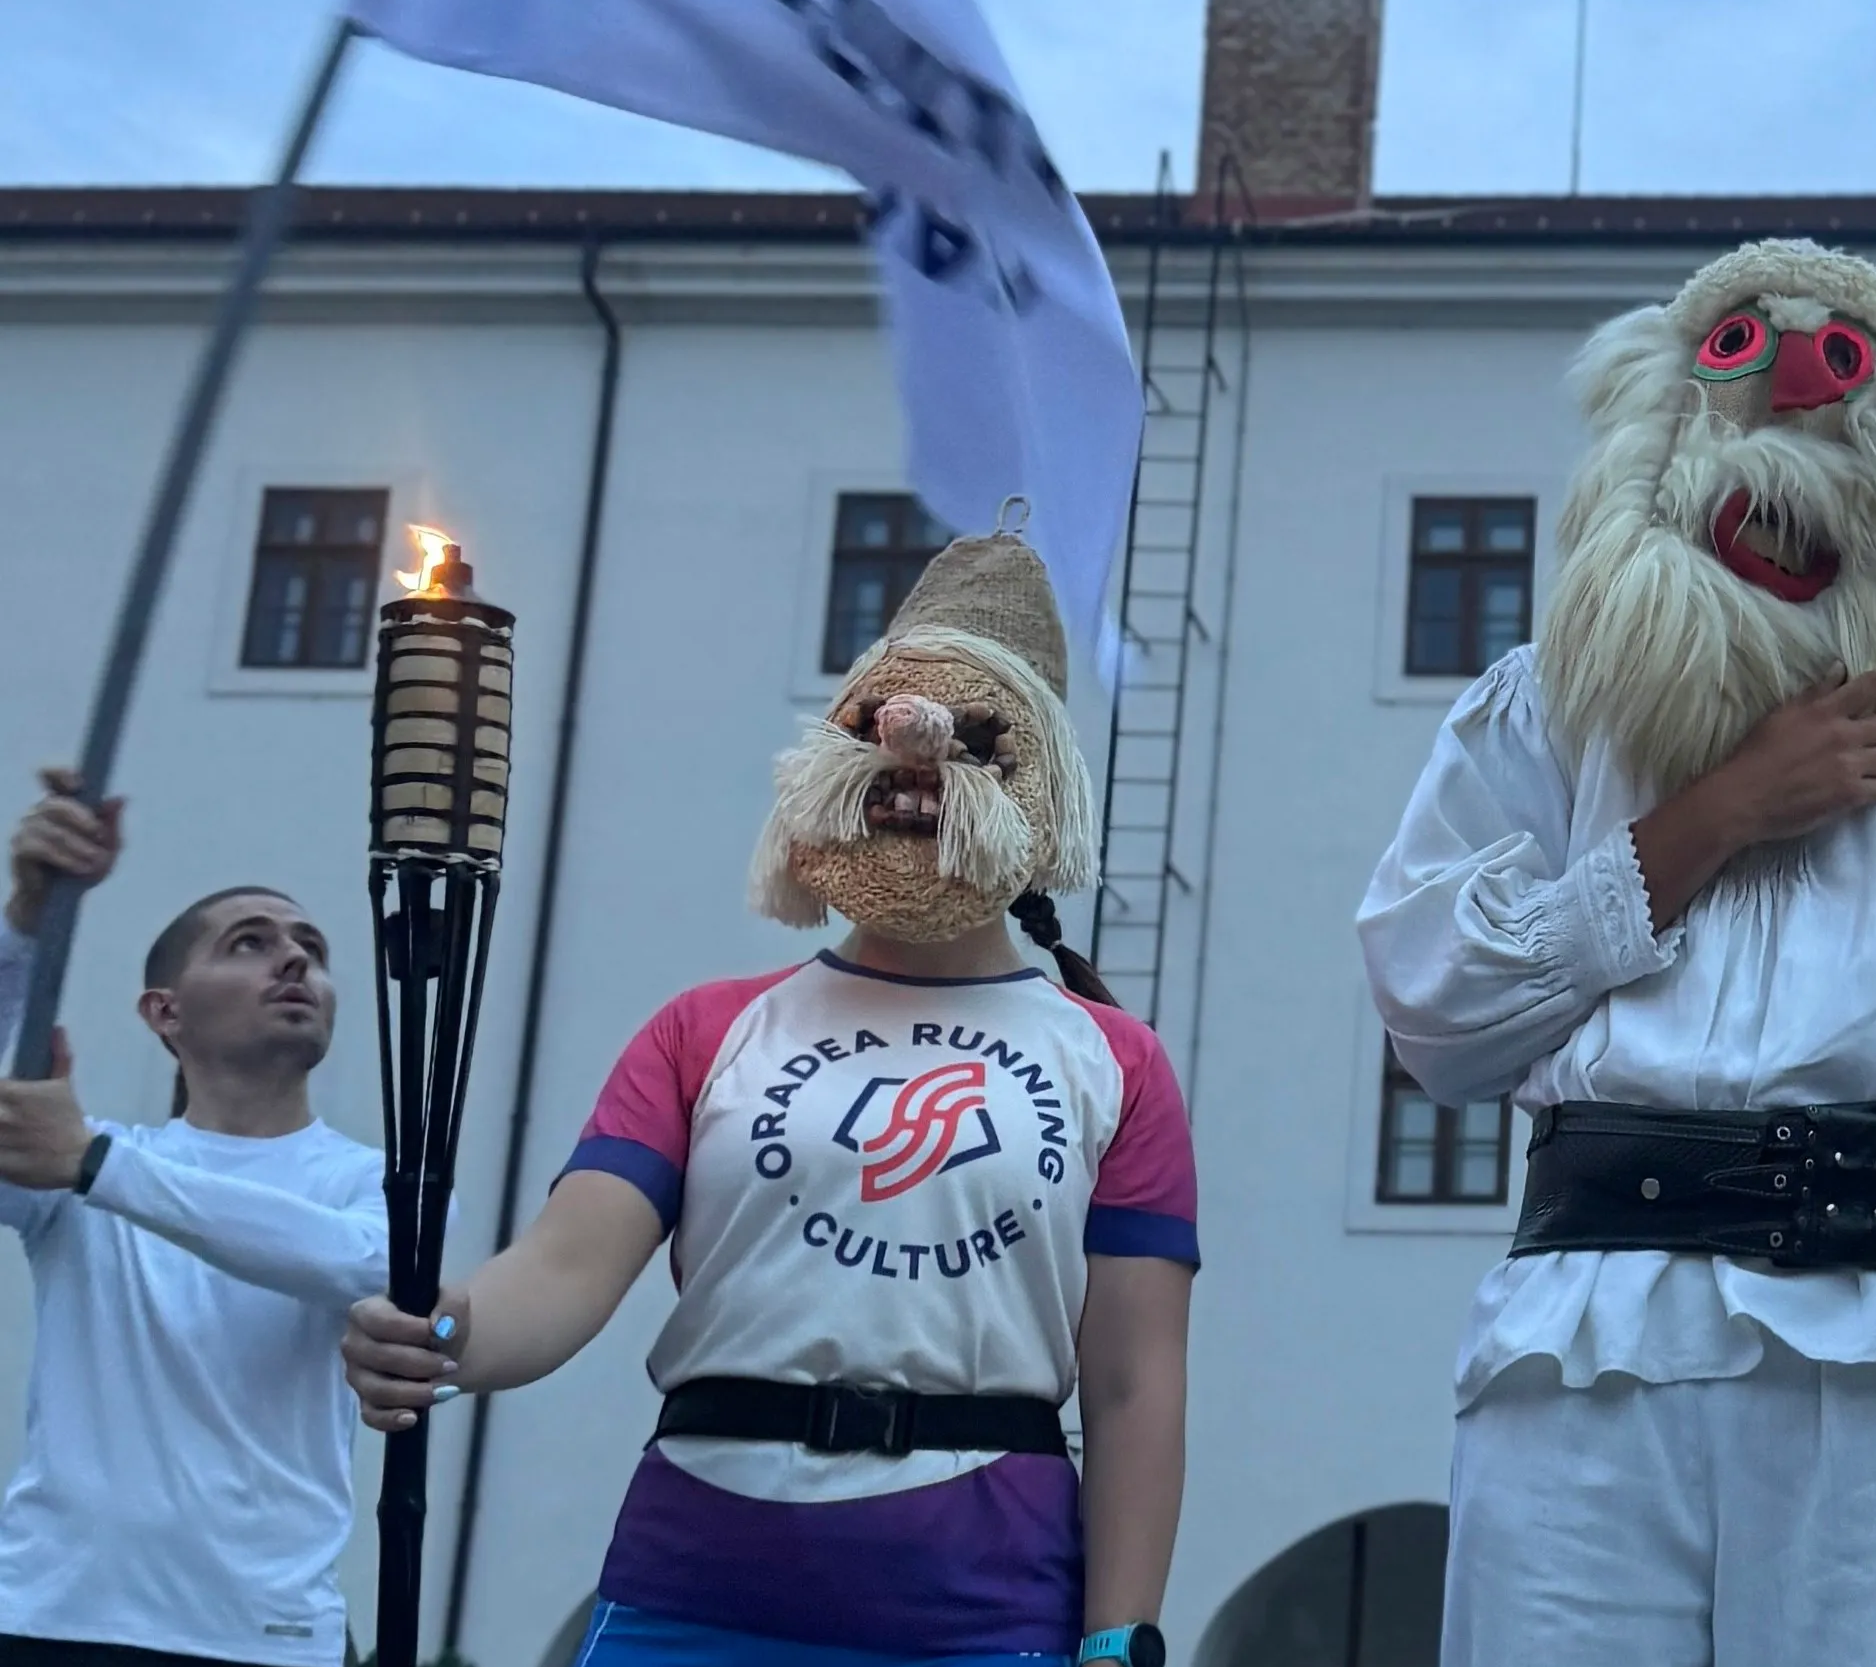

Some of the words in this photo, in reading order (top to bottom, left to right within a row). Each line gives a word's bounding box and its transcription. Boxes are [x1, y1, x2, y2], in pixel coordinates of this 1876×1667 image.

[750, 1028, 890, 1180] ORADEA
[911, 1022, 1068, 1185] RUNNING
[801, 1208, 1027, 1281] CULTURE
